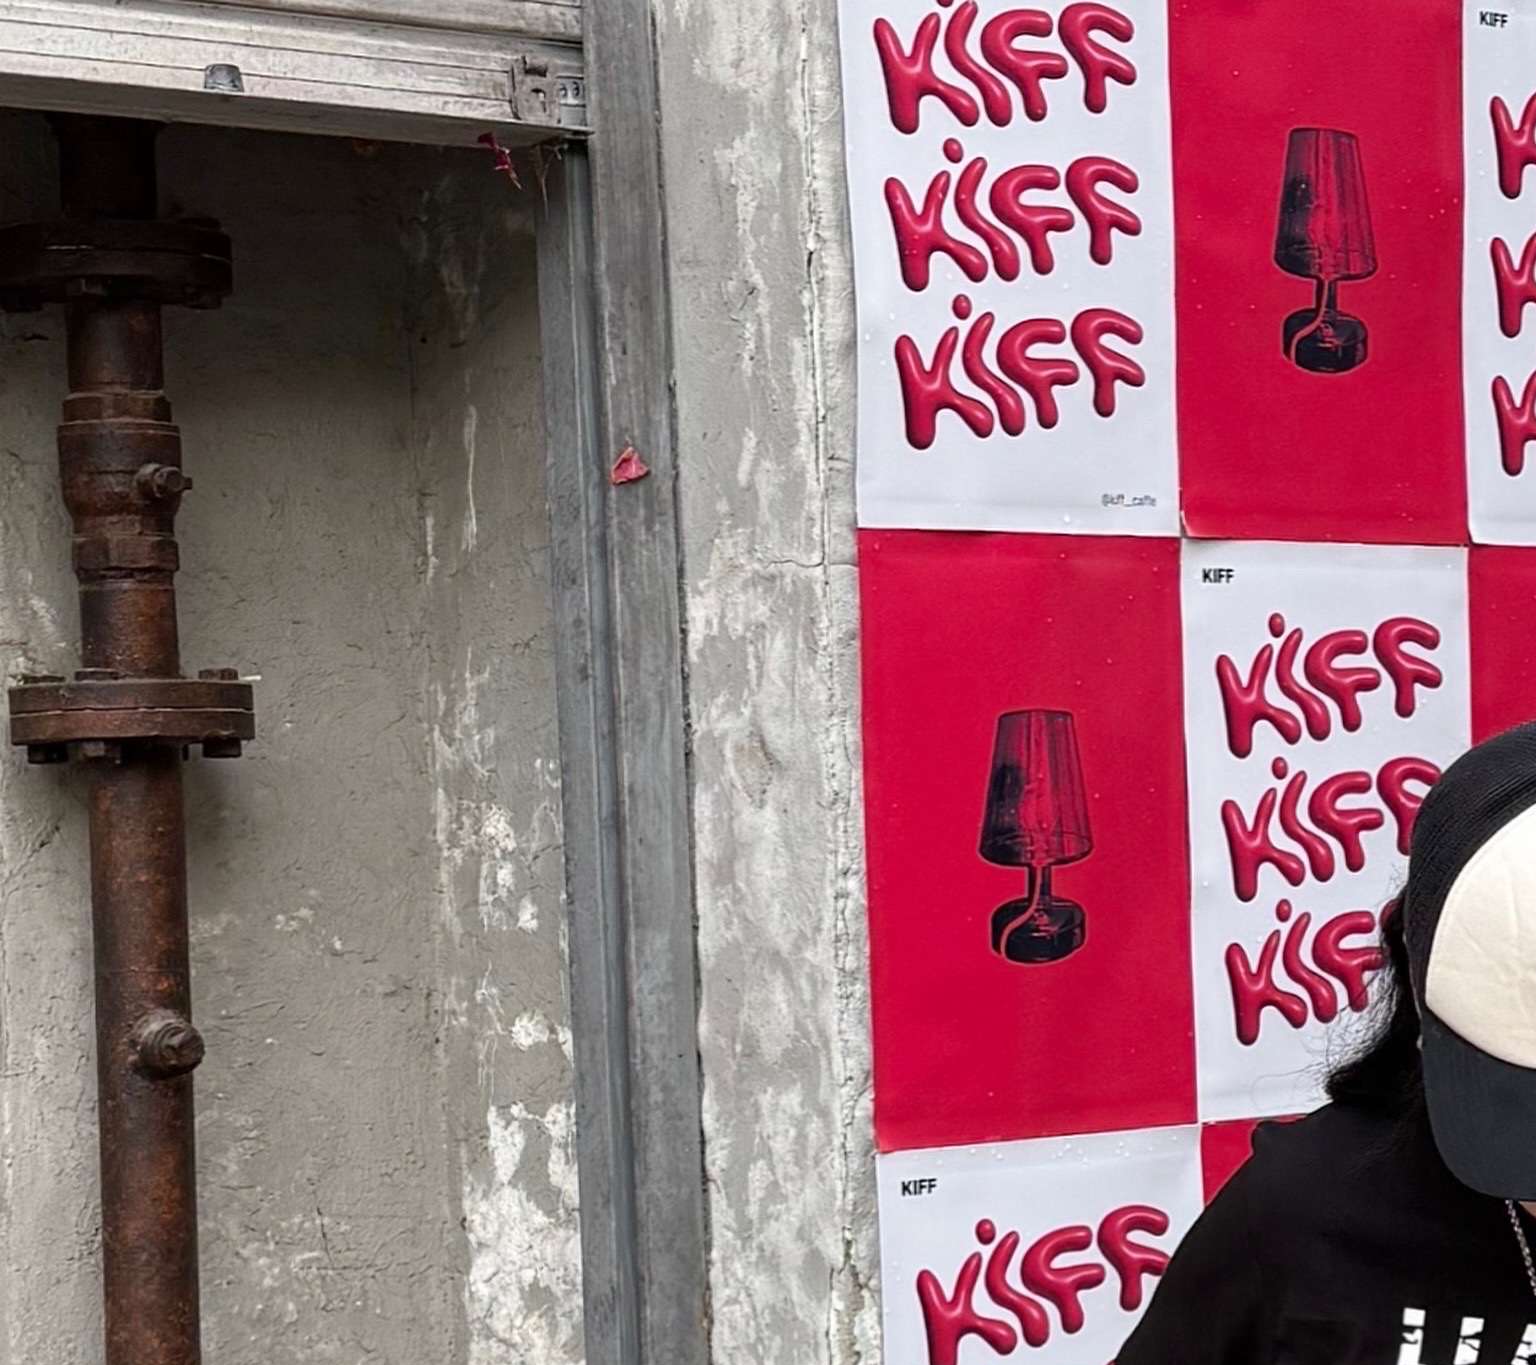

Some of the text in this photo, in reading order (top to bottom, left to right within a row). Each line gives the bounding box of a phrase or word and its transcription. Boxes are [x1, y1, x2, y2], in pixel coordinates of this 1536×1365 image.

[1478, 11, 1509, 29] KIFF
[1201, 567, 1235, 585] KIFF
[900, 1178, 938, 1197] KIFF
